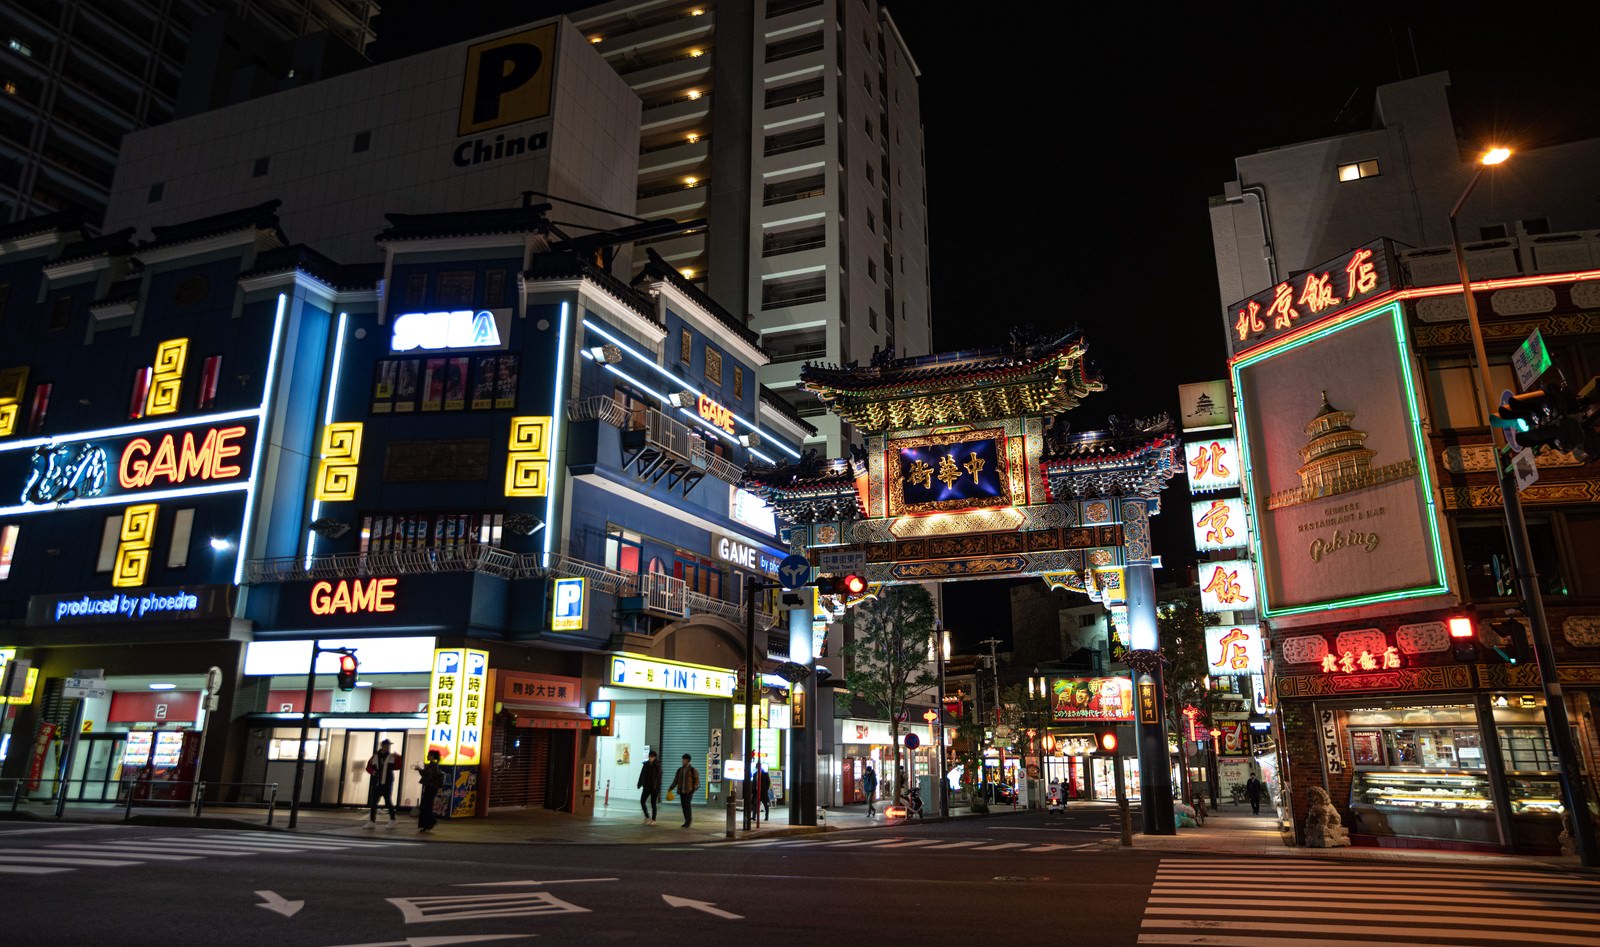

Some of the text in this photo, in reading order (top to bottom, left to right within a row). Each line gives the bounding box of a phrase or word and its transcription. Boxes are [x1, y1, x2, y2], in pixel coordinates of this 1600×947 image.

[472, 42, 543, 125] P
[453, 131, 548, 168] China
[1235, 248, 1378, 341] 北京飯店
[697, 394, 737, 435] GAME
[119, 425, 246, 489] GAME
[1298, 512, 1355, 533] RESTAURANT
[1366, 507, 1386, 518] BAR
[1324, 502, 1360, 517] CHINESE
[718, 537, 757, 570] GAME
[759, 555, 770, 573] by
[1309, 529, 1380, 563] Peking
[55, 590, 198, 622] produced by phoedra
[309, 578, 398, 616] GAME
[557, 584, 581, 616] P
[438, 652, 459, 674] P
[468, 652, 485, 676] P
[1320, 646, 1402, 675] 北京飯店
[673, 669, 688, 689] IN
[158, 704, 166, 717] 2
[435, 675, 456, 726] 時間貸
[465, 676, 481, 727] 時間貸
[83, 721, 93, 733] 2
[431, 728, 452, 742] IN
[461, 729, 478, 743] IN
[1321, 710, 1341, 773] タピオカ
